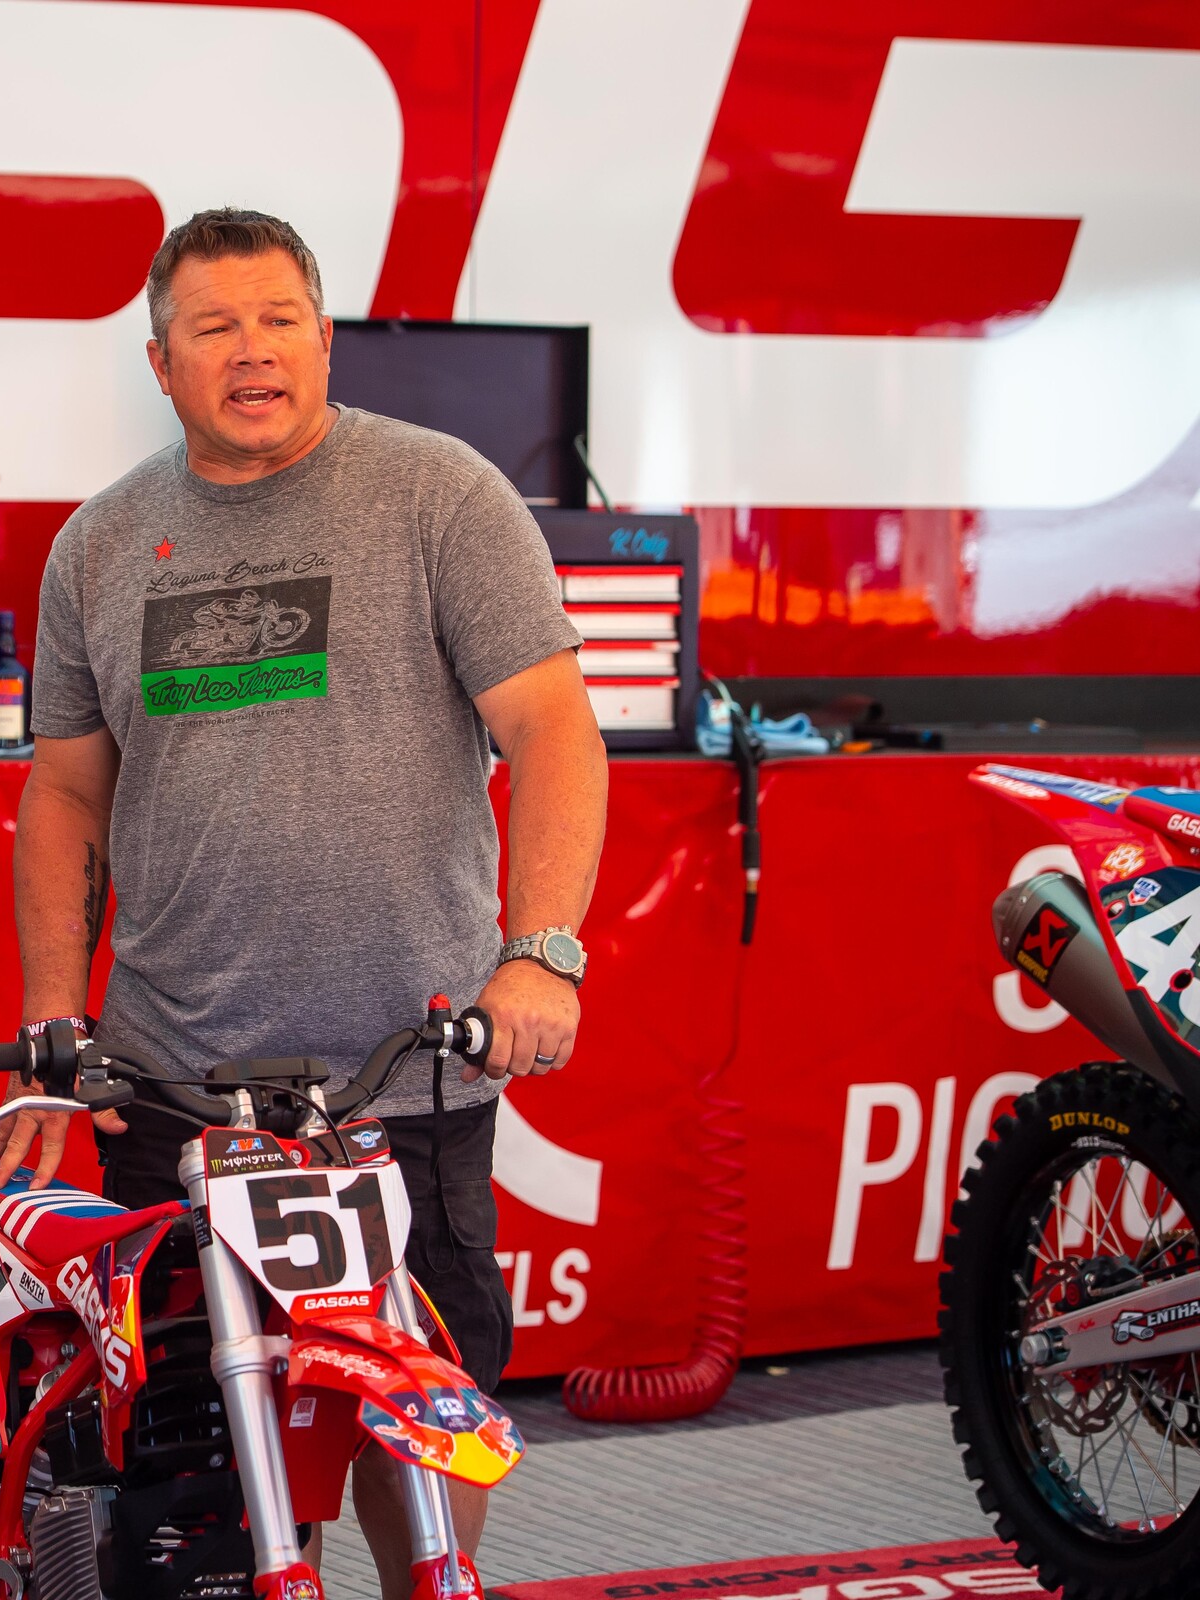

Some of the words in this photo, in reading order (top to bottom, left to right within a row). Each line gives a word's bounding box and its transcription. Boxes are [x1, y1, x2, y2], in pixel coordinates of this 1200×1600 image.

[146, 571, 220, 594] Laguna
[224, 558, 291, 584] Beach
[292, 552, 334, 574] Ca.
[147, 675, 194, 710] Troy
[190, 673, 237, 703] Lee
[236, 665, 323, 699] Designs
[1048, 1111, 1131, 1135] DUNLOP
[222, 1152, 284, 1168] MONSTER
[226, 1137, 264, 1153] AMA
[233, 1163, 277, 1173] ENERGY
[245, 1172, 395, 1292] 51
[19, 1271, 46, 1301] BN3TH
[494, 1247, 591, 1329] LS
[303, 1295, 370, 1310] GASGAS
[604, 1561, 877, 1600] RACING
